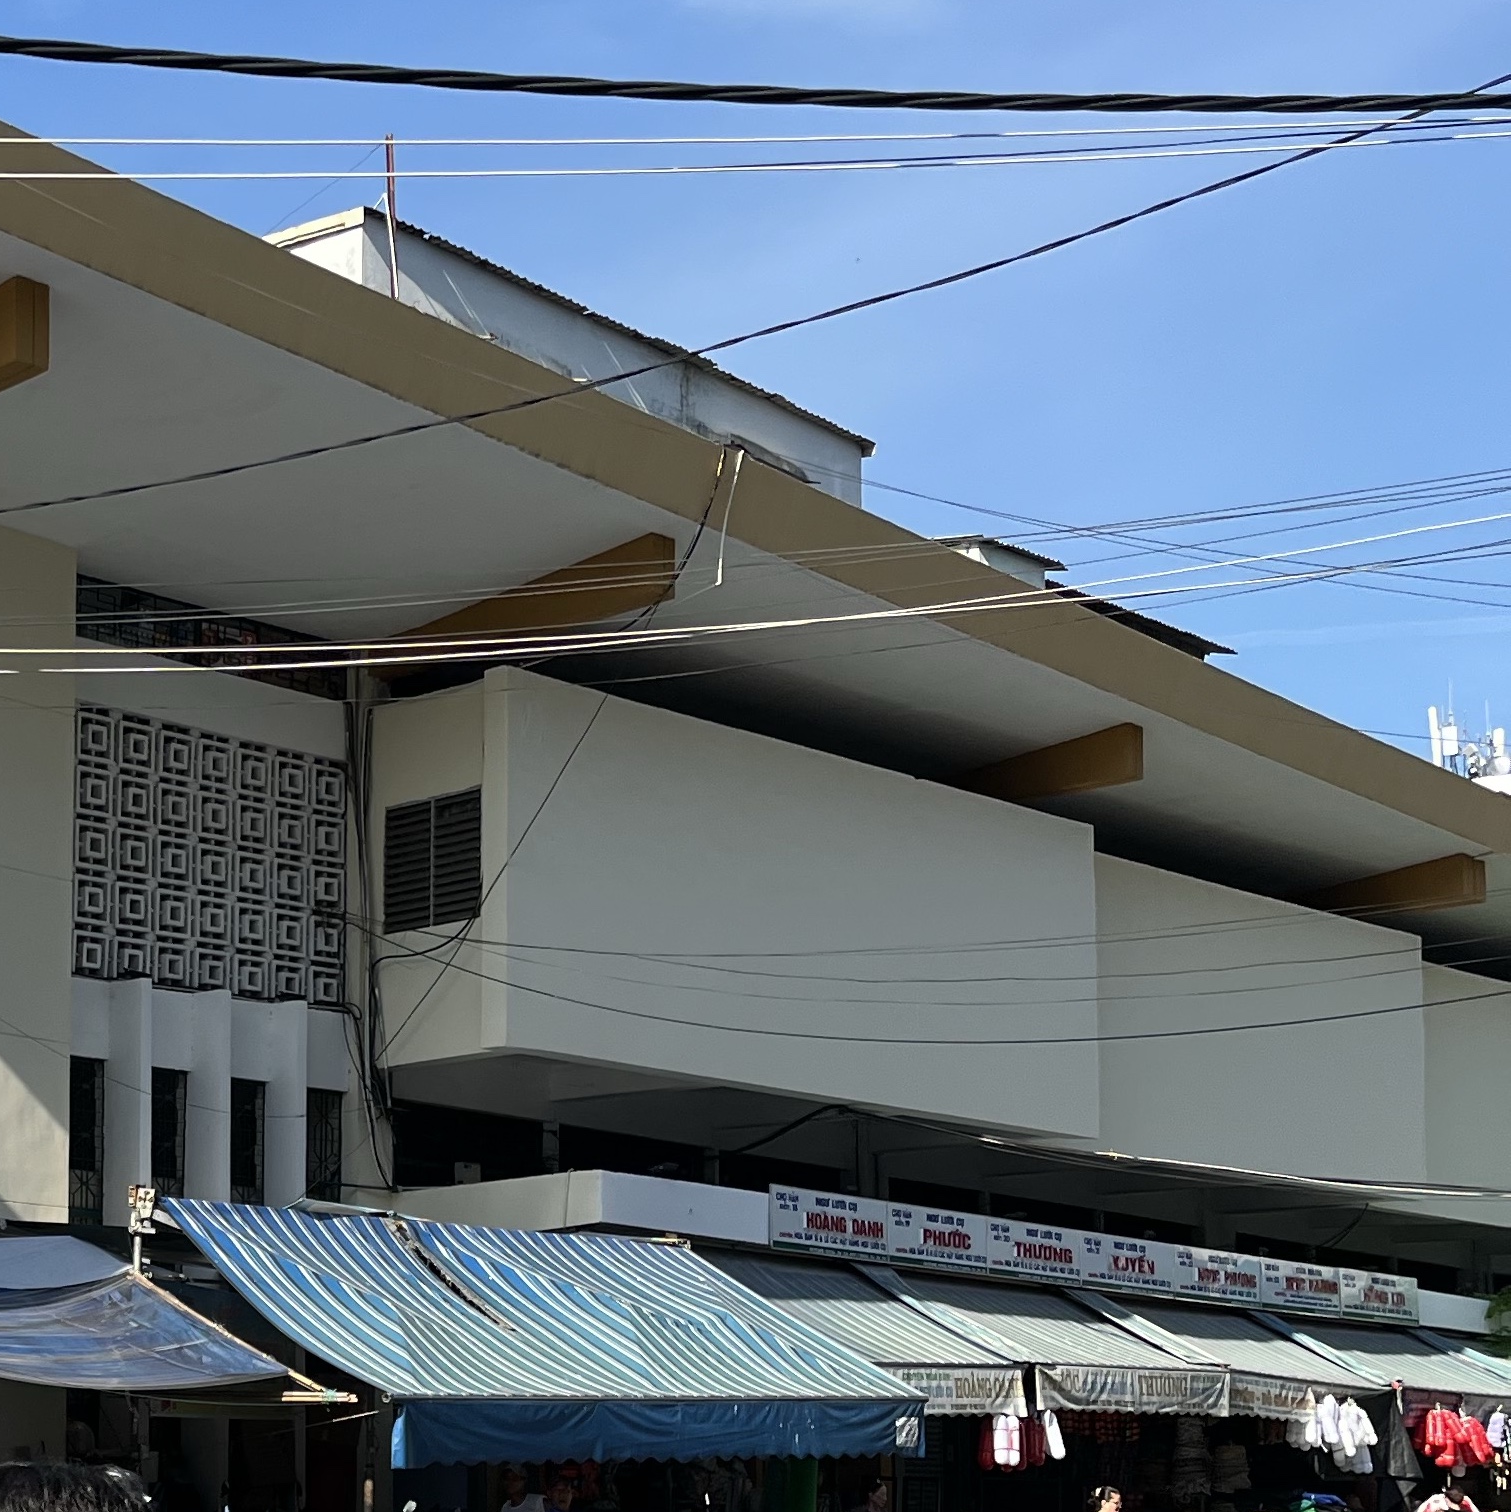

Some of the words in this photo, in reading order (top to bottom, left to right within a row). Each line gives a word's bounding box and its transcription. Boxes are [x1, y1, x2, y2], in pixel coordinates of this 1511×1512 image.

[805, 1211, 847, 1233] HOÀNG
[851, 1218, 884, 1238] OANH
[922, 1228, 972, 1250] PHƯỚC
